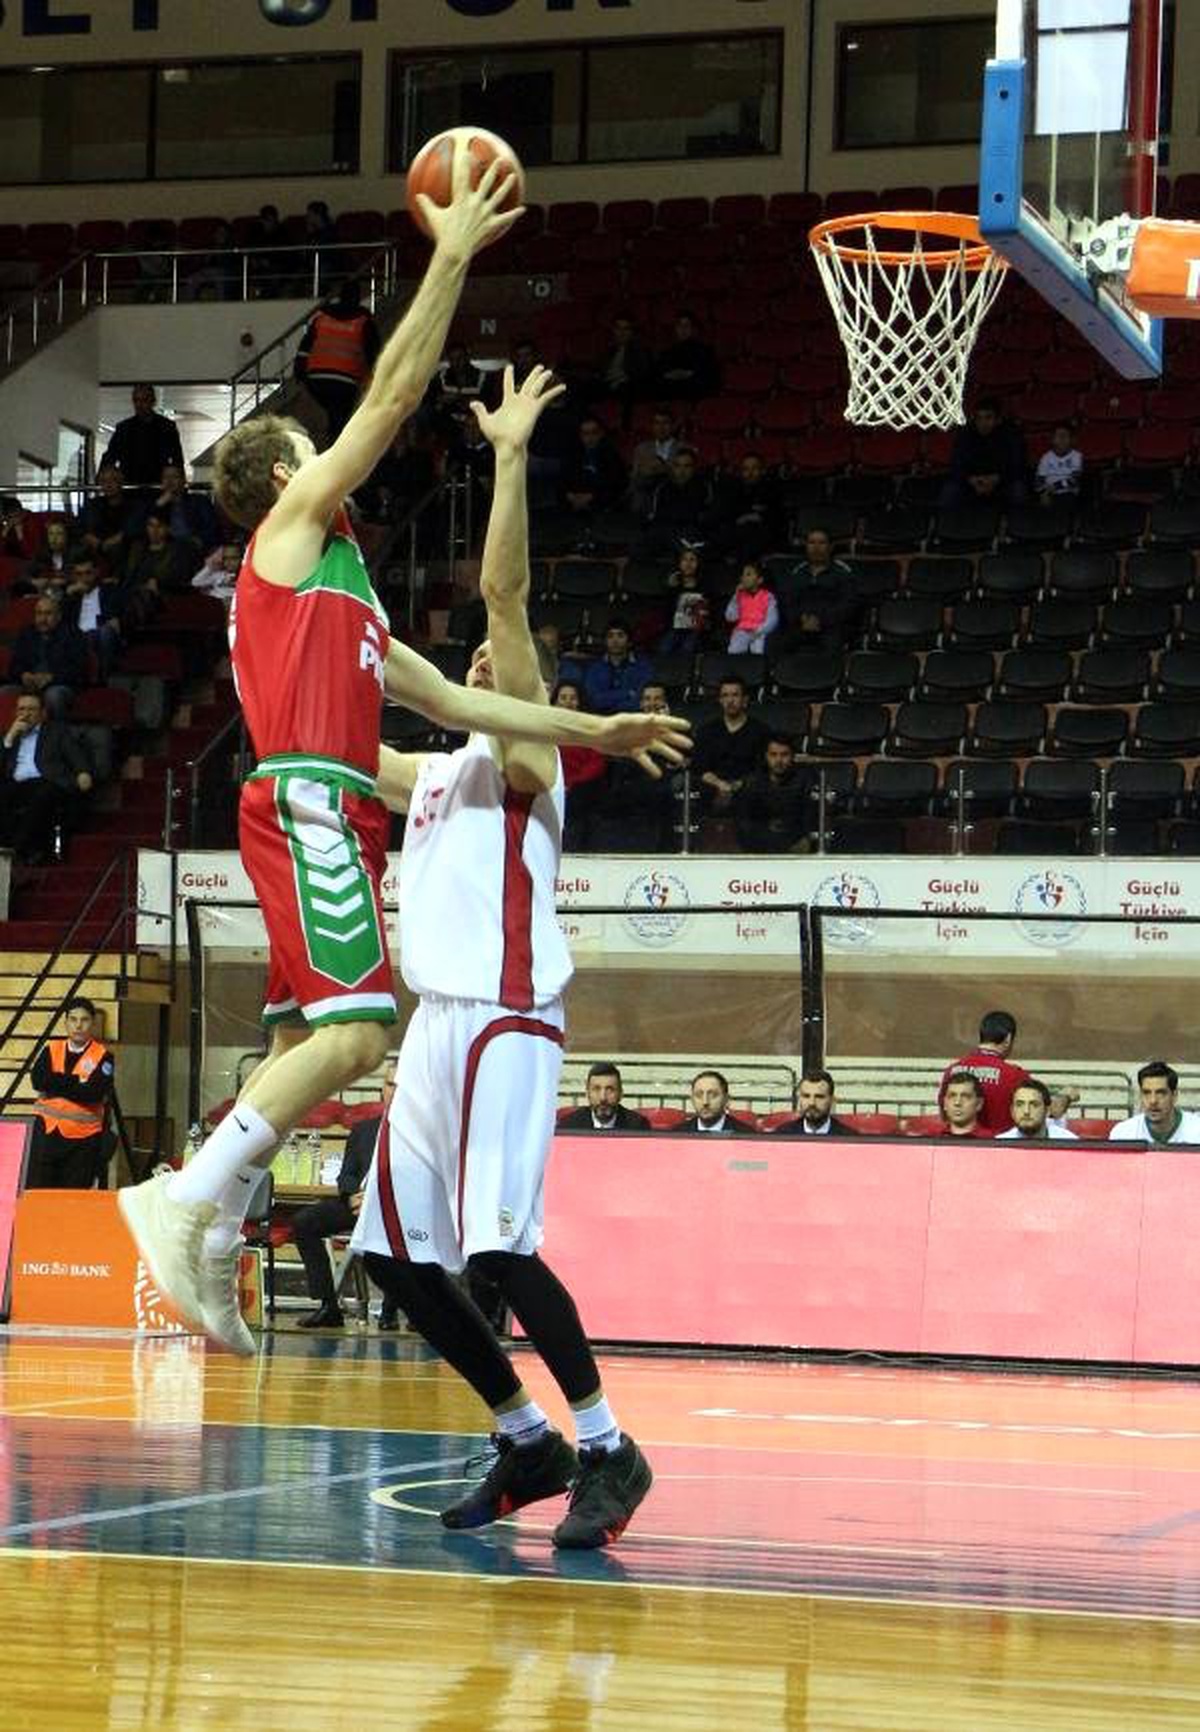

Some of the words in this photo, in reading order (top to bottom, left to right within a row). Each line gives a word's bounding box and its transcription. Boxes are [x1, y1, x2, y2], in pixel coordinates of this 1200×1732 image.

[181, 873, 229, 890] Güçlü
[728, 879, 779, 896] Güçlü
[928, 879, 979, 897] Güçlü
[1127, 880, 1180, 898] Güçlü
[22, 1263, 49, 1275] ING
[70, 1263, 111, 1277] BANK
